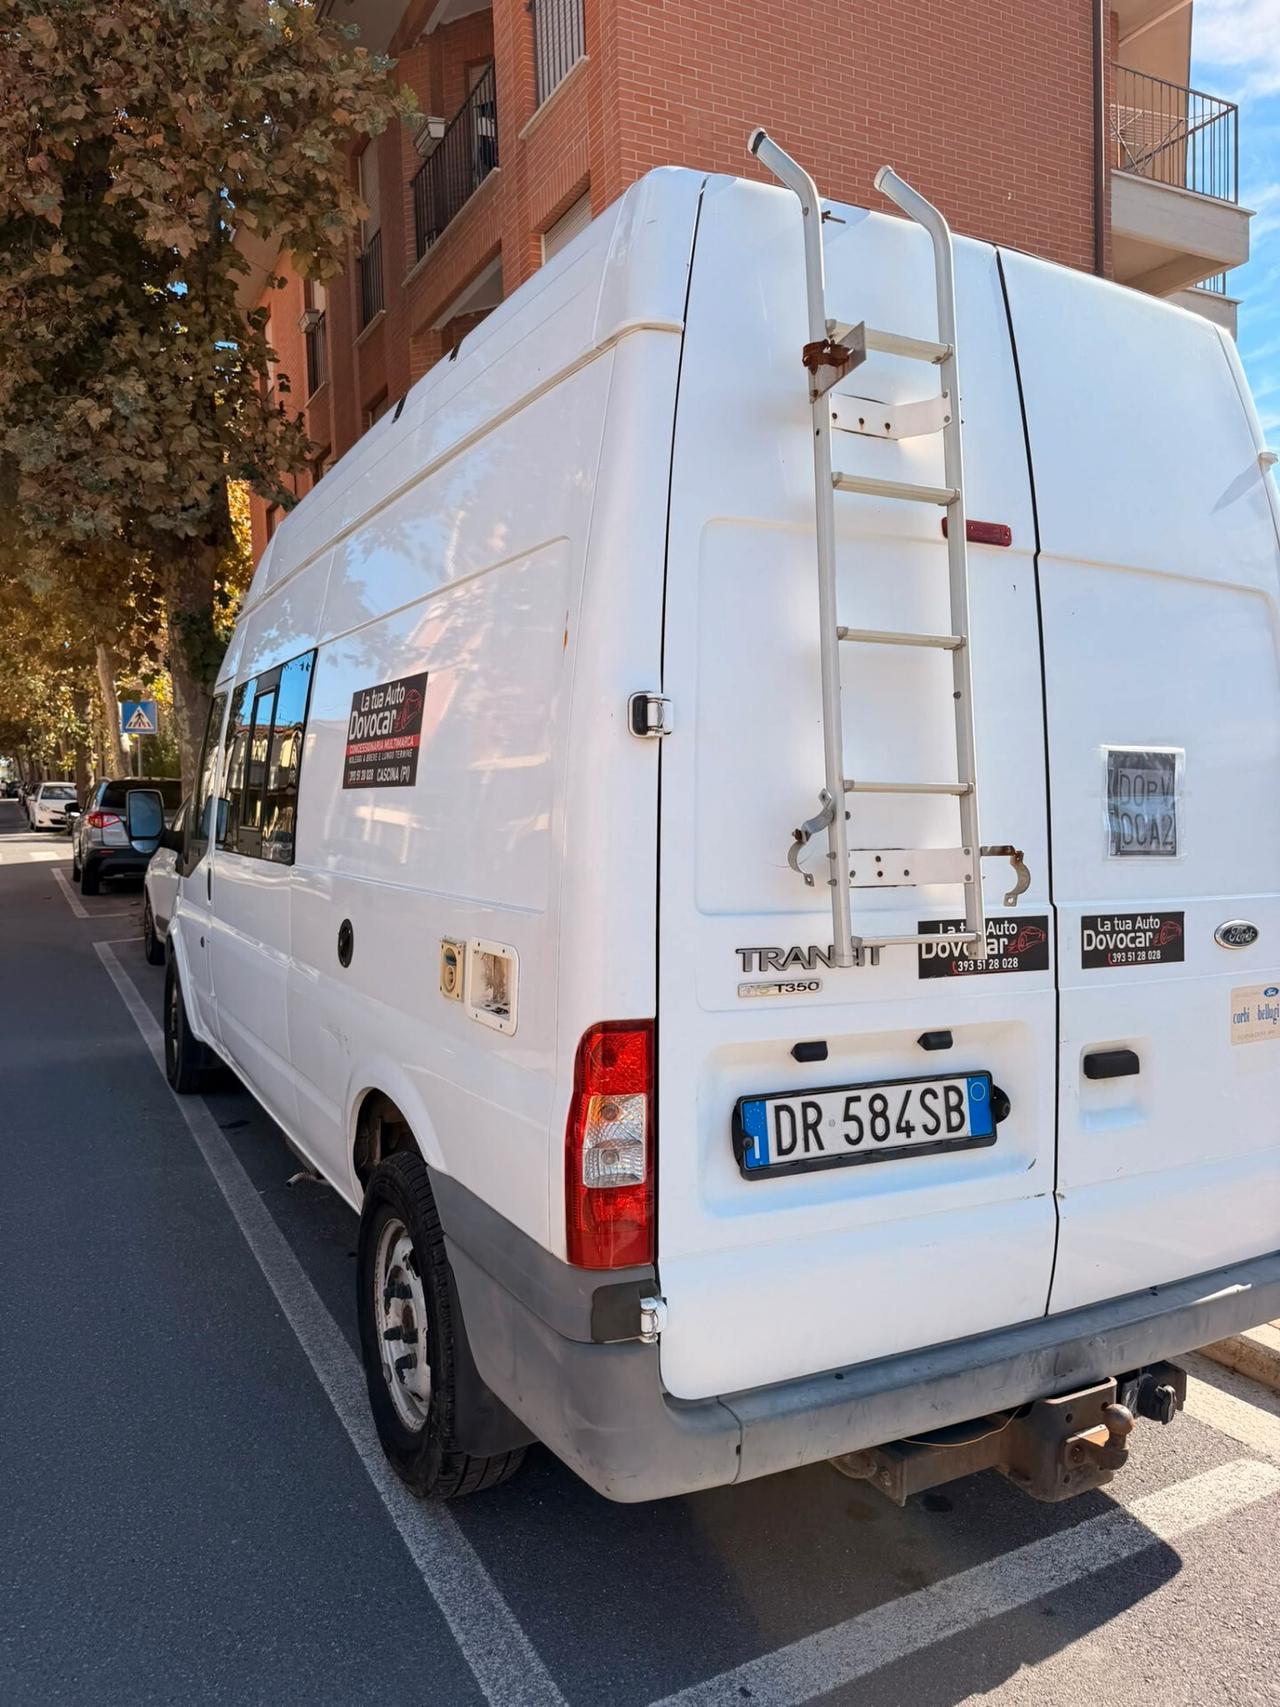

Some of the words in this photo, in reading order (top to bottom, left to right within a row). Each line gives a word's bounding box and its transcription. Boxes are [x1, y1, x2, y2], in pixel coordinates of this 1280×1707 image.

[361, 692, 370, 712] La
[371, 690, 384, 709] tua
[385, 682, 405, 706] Auto
[349, 709, 397, 740] Dovocar
[377, 767, 399, 782] CASCINA
[986, 920, 1018, 936] Auto
[1097, 917, 1111, 932] La
[1113, 917, 1132, 931] tua
[1135, 915, 1160, 930] Auto
[1083, 929, 1153, 951] Dovocar
[736, 945, 886, 972] TRANIT
[958, 960, 974, 972] 393
[977, 960, 986, 970] 51
[989, 959, 1000, 970] 28
[1002, 957, 1019, 968] 028
[1112, 952, 1126, 963] 393
[1127, 951, 1136, 962] 51
[1137, 951, 1146, 961] 28
[1147, 950, 1161, 960] 028
[774, 981, 820, 993] T350
[774, 1101, 825, 1156] DR
[843, 1084, 966, 1146] 584SB
